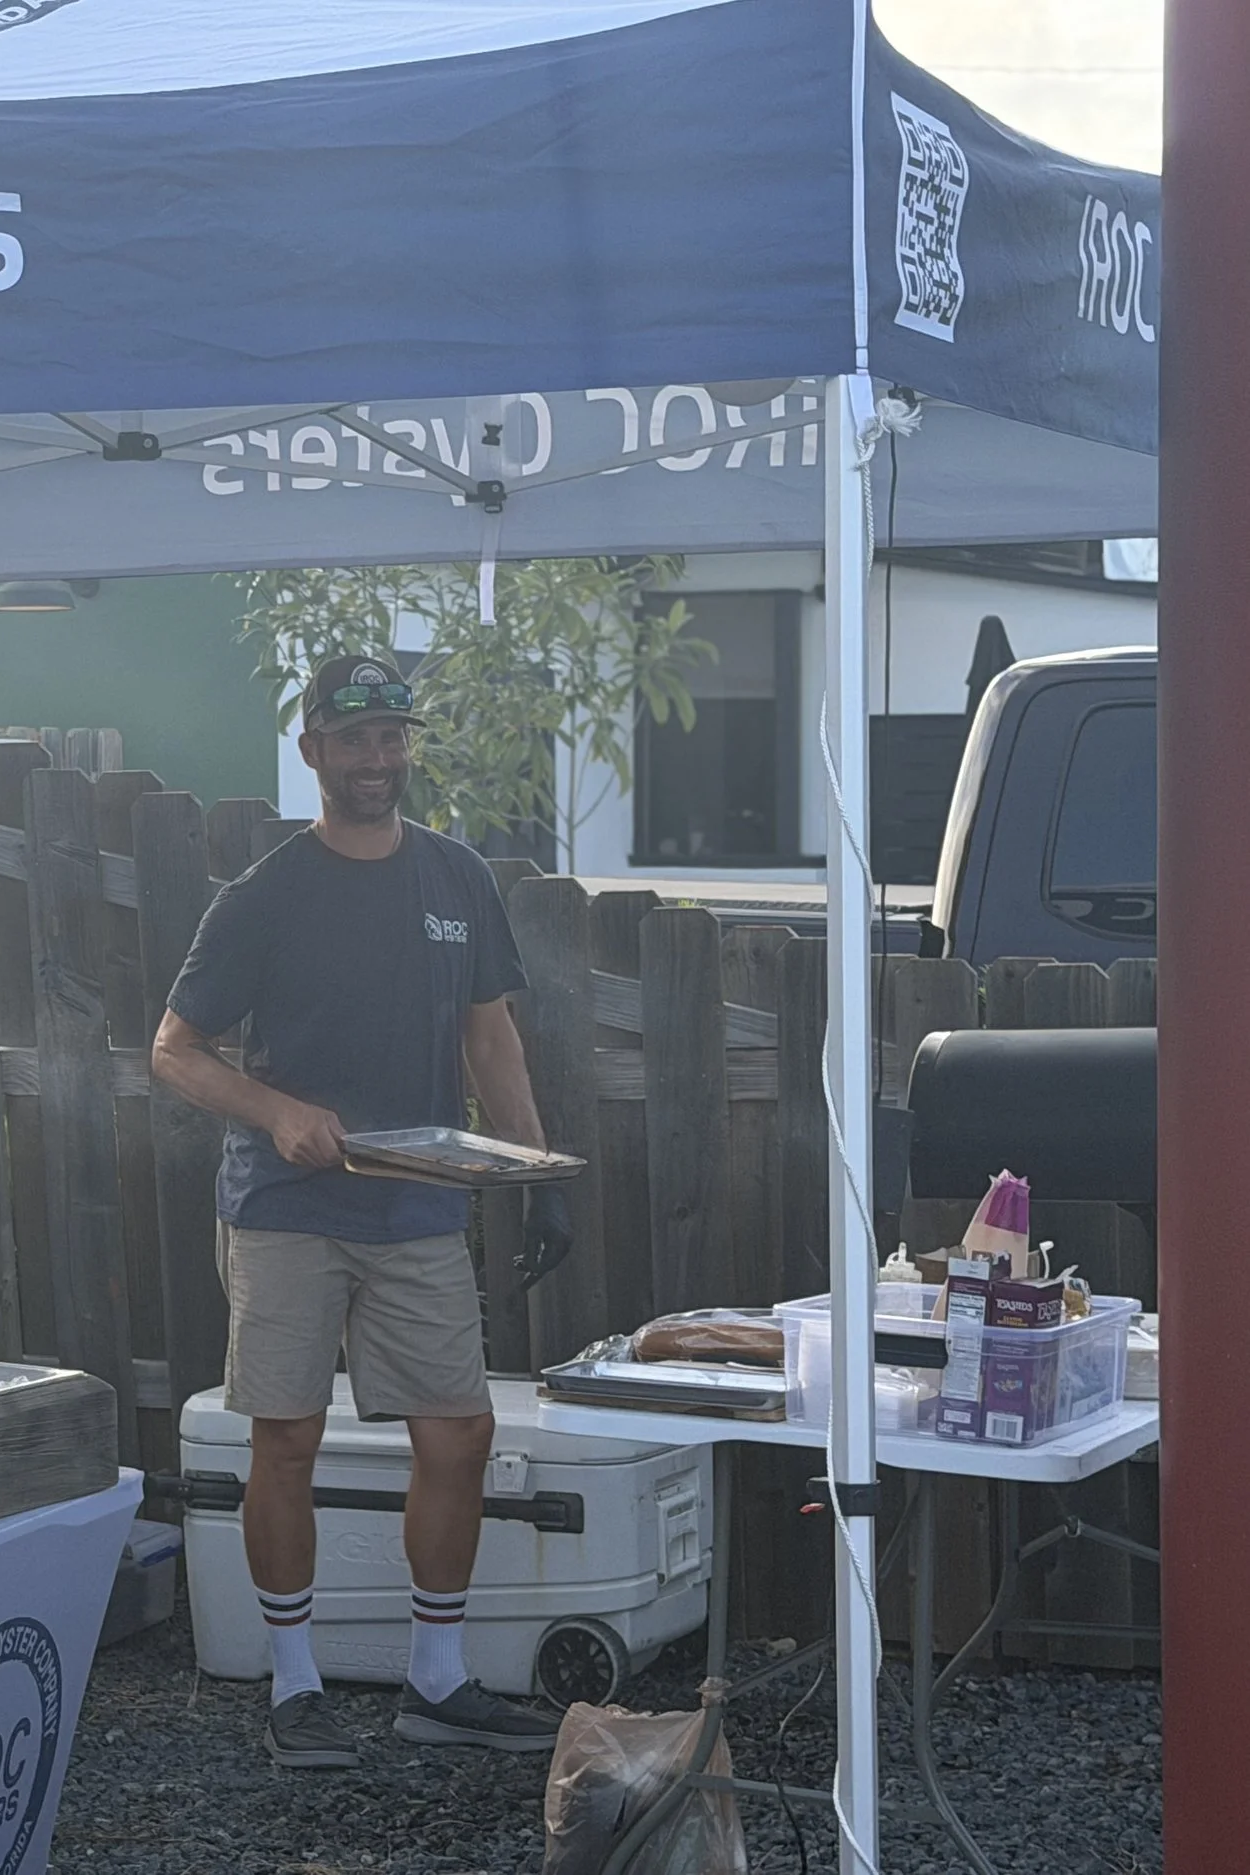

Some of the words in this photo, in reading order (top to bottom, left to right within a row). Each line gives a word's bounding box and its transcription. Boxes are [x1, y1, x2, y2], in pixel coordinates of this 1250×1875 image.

[1077, 194, 1156, 343] IROC
[33, 1639, 60, 1738] COMPANY
[2, 1820, 33, 1875] ORIDA
